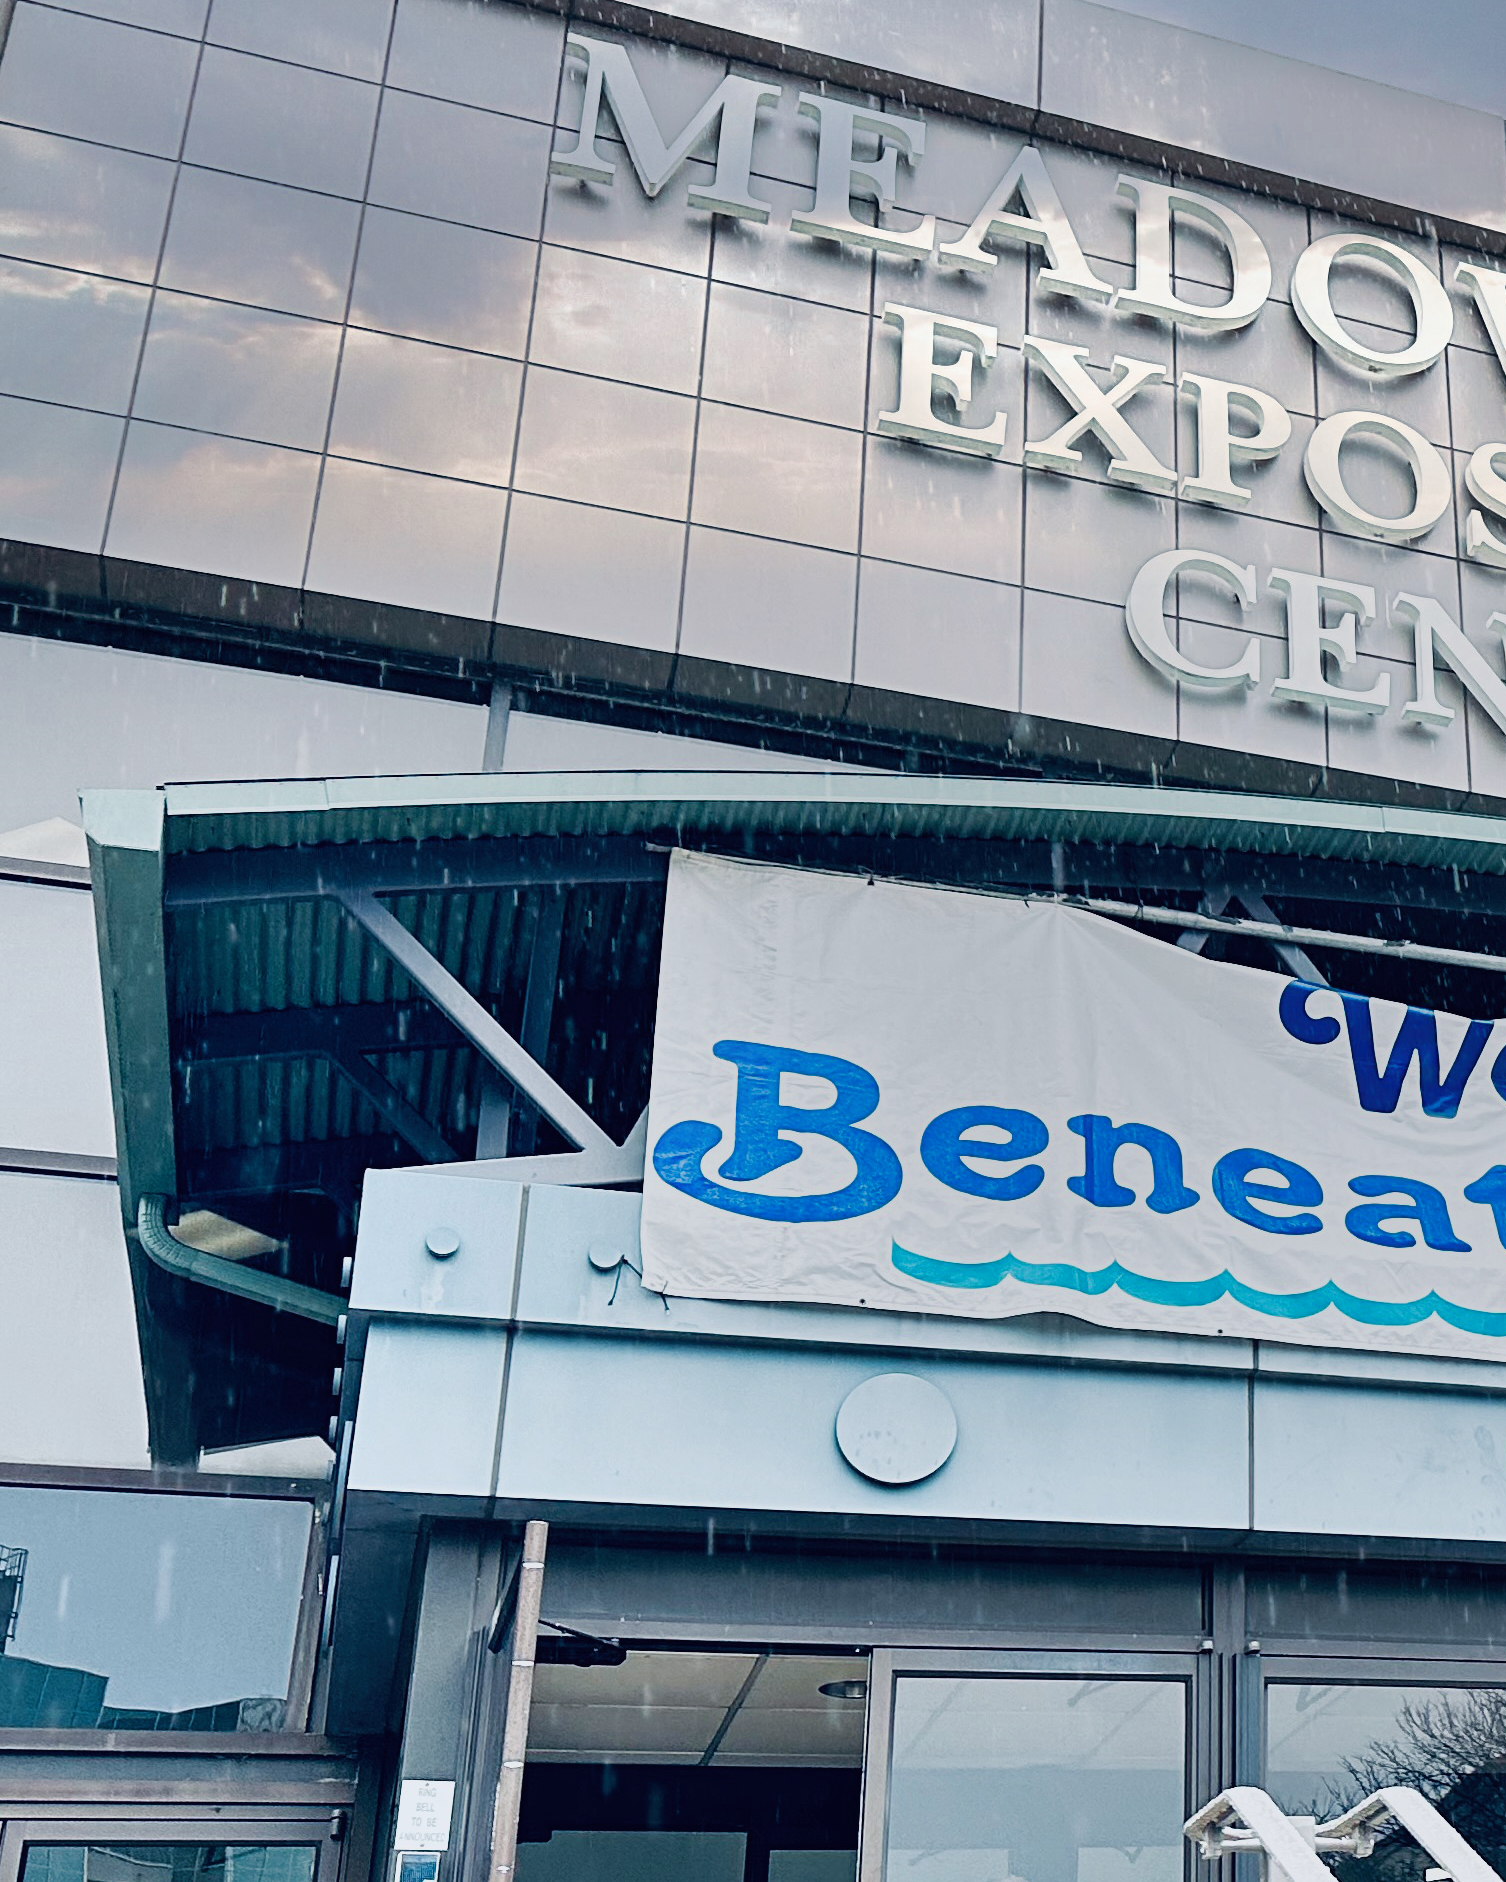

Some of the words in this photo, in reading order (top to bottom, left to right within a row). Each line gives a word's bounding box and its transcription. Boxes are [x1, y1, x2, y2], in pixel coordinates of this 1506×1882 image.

[418, 1787, 437, 1798] RING
[415, 1802, 435, 1813] BELL
[411, 1816, 422, 1828] TO
[426, 1817, 437, 1828] BE
[399, 1832, 445, 1843] ANNOUNCED
